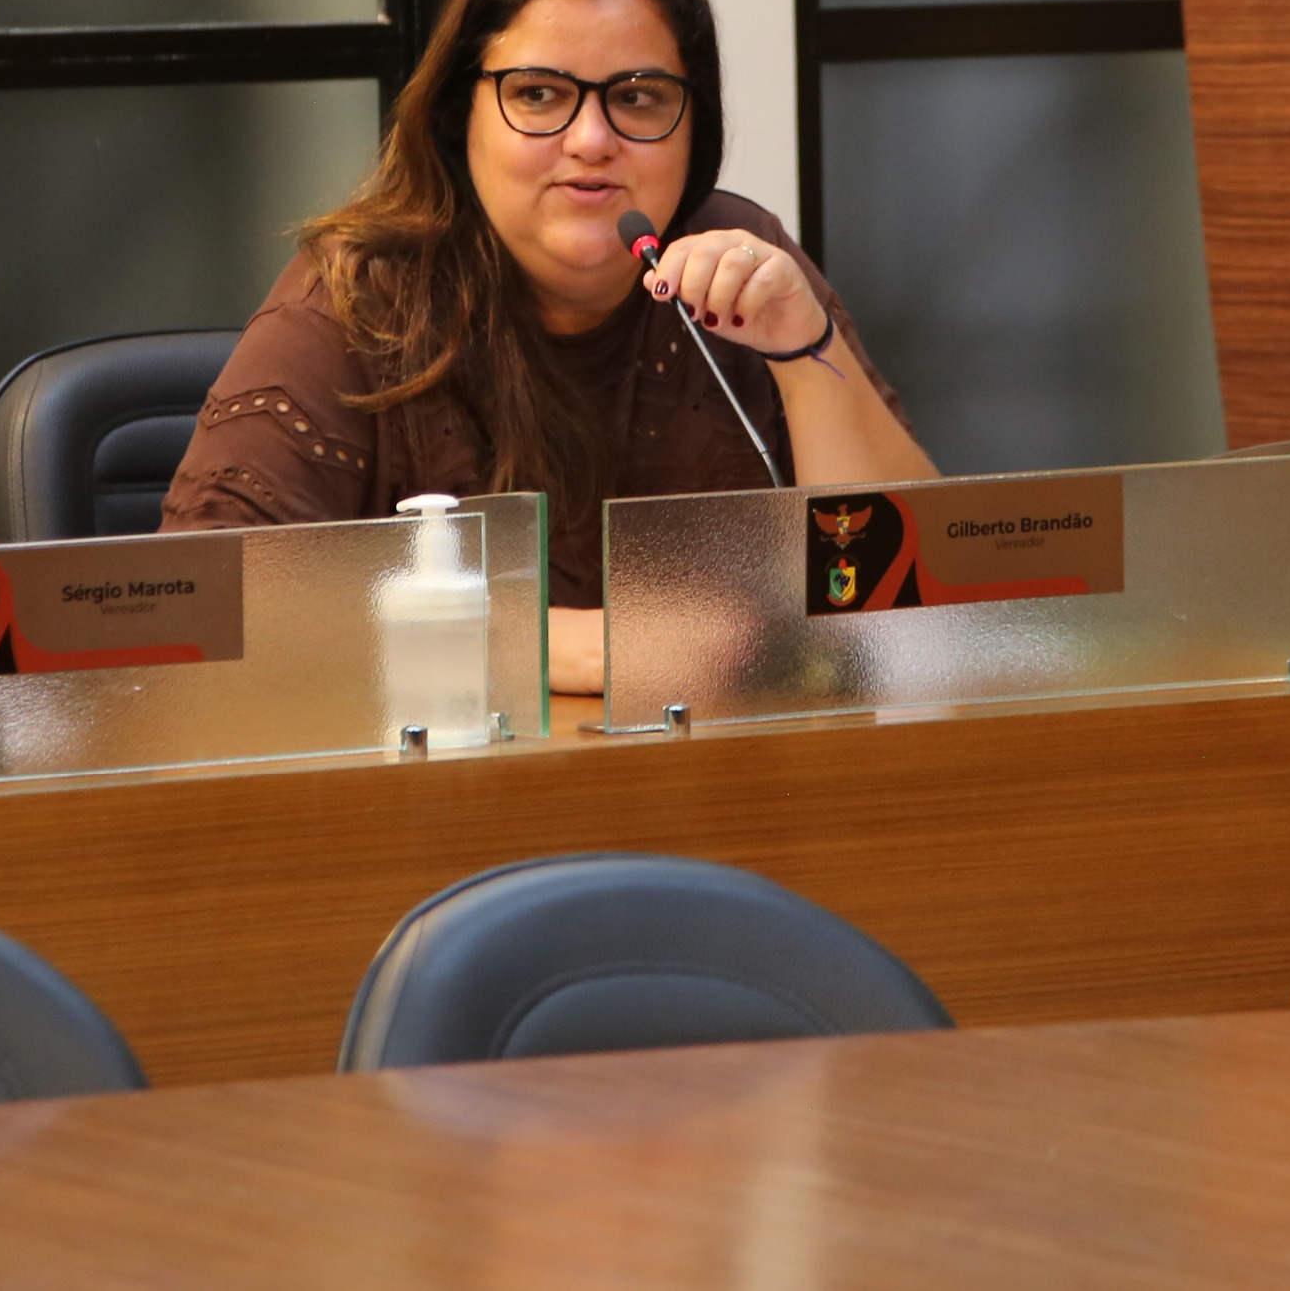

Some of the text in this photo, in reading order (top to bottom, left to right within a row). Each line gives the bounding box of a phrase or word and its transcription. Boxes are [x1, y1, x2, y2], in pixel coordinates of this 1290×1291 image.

[947, 513, 1094, 539] Gilberto Brandão
[995, 536, 1046, 551] Vereador
[61, 579, 196, 604] Sérgio Marota
[100, 601, 156, 616] Vereador
